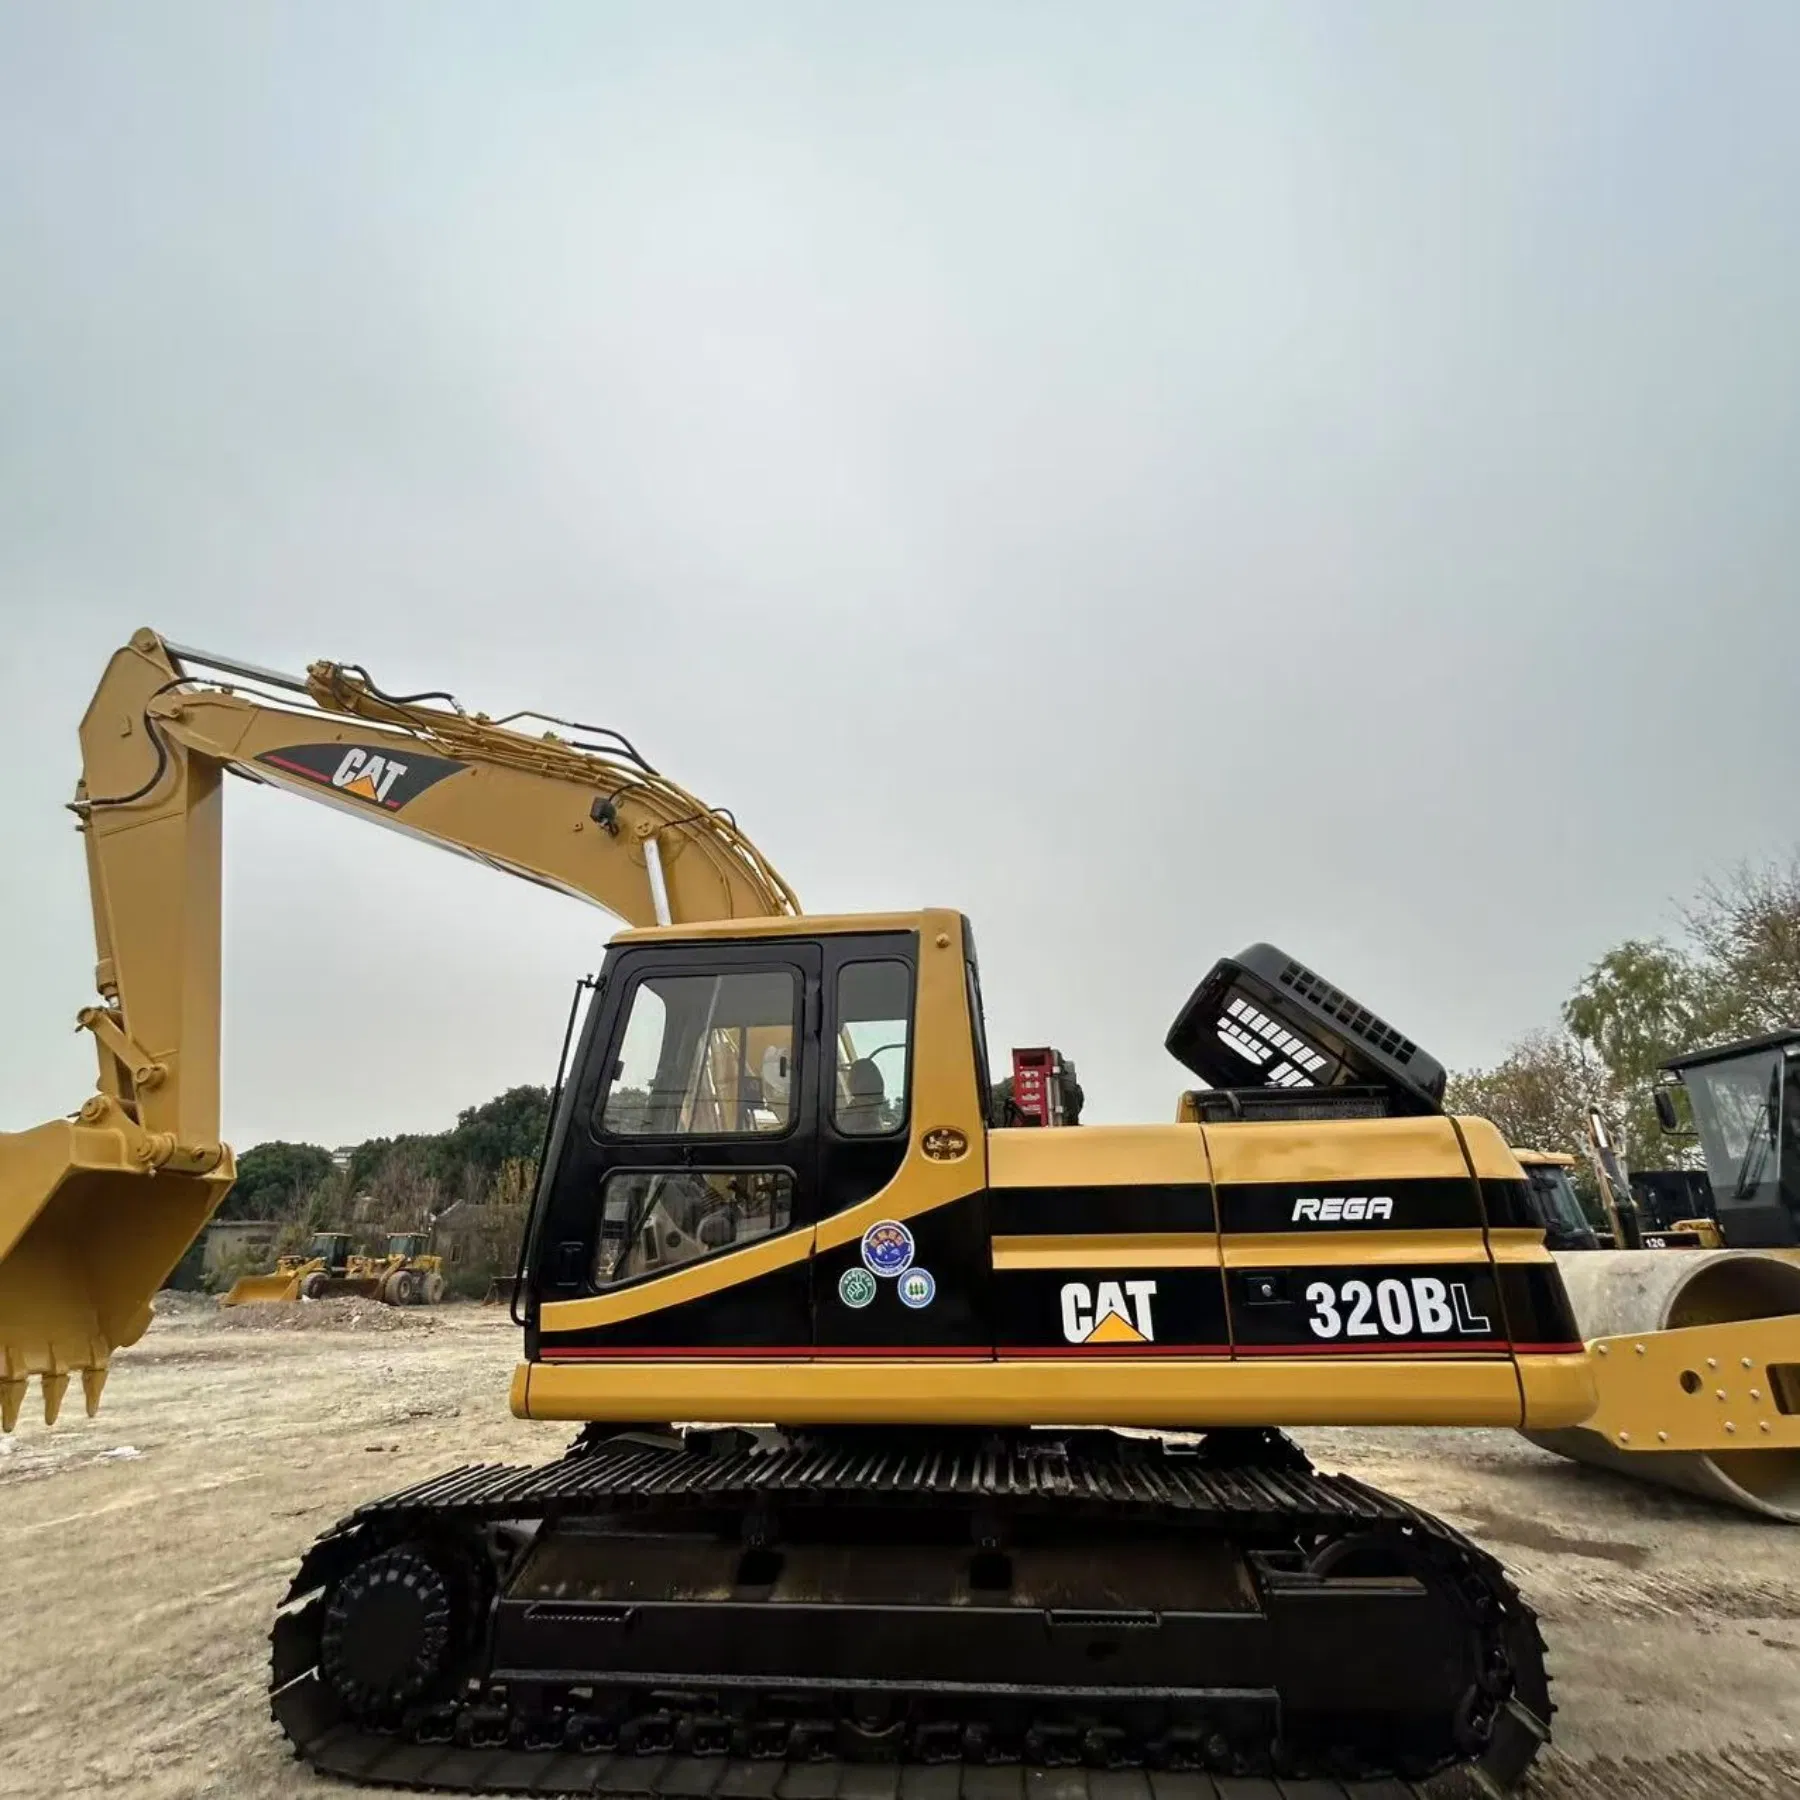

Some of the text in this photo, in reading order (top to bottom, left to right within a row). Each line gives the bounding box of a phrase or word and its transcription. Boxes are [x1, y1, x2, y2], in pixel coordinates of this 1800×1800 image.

[333, 749, 407, 801] CAT
[1291, 1197, 1393, 1221] REGA
[1060, 1280, 1157, 1344] CAT
